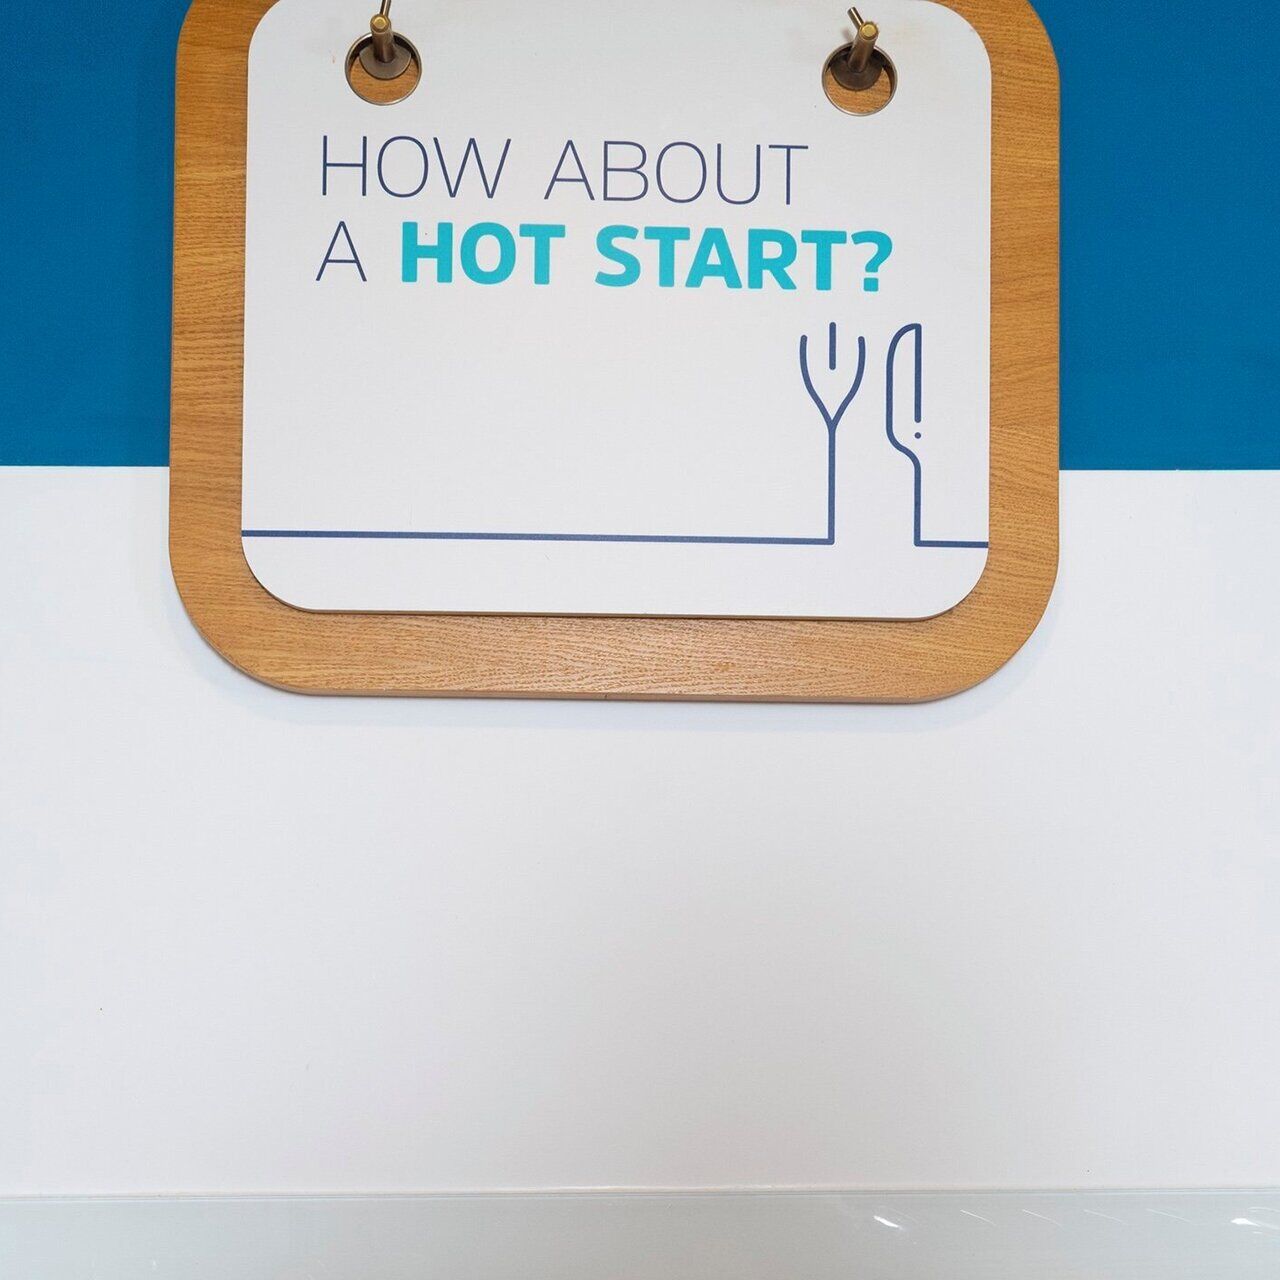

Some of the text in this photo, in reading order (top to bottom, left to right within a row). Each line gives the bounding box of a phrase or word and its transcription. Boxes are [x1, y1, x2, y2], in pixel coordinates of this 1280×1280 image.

[321, 134, 809, 206] HOW ABOUT
[315, 220, 893, 292] A HOT START?
